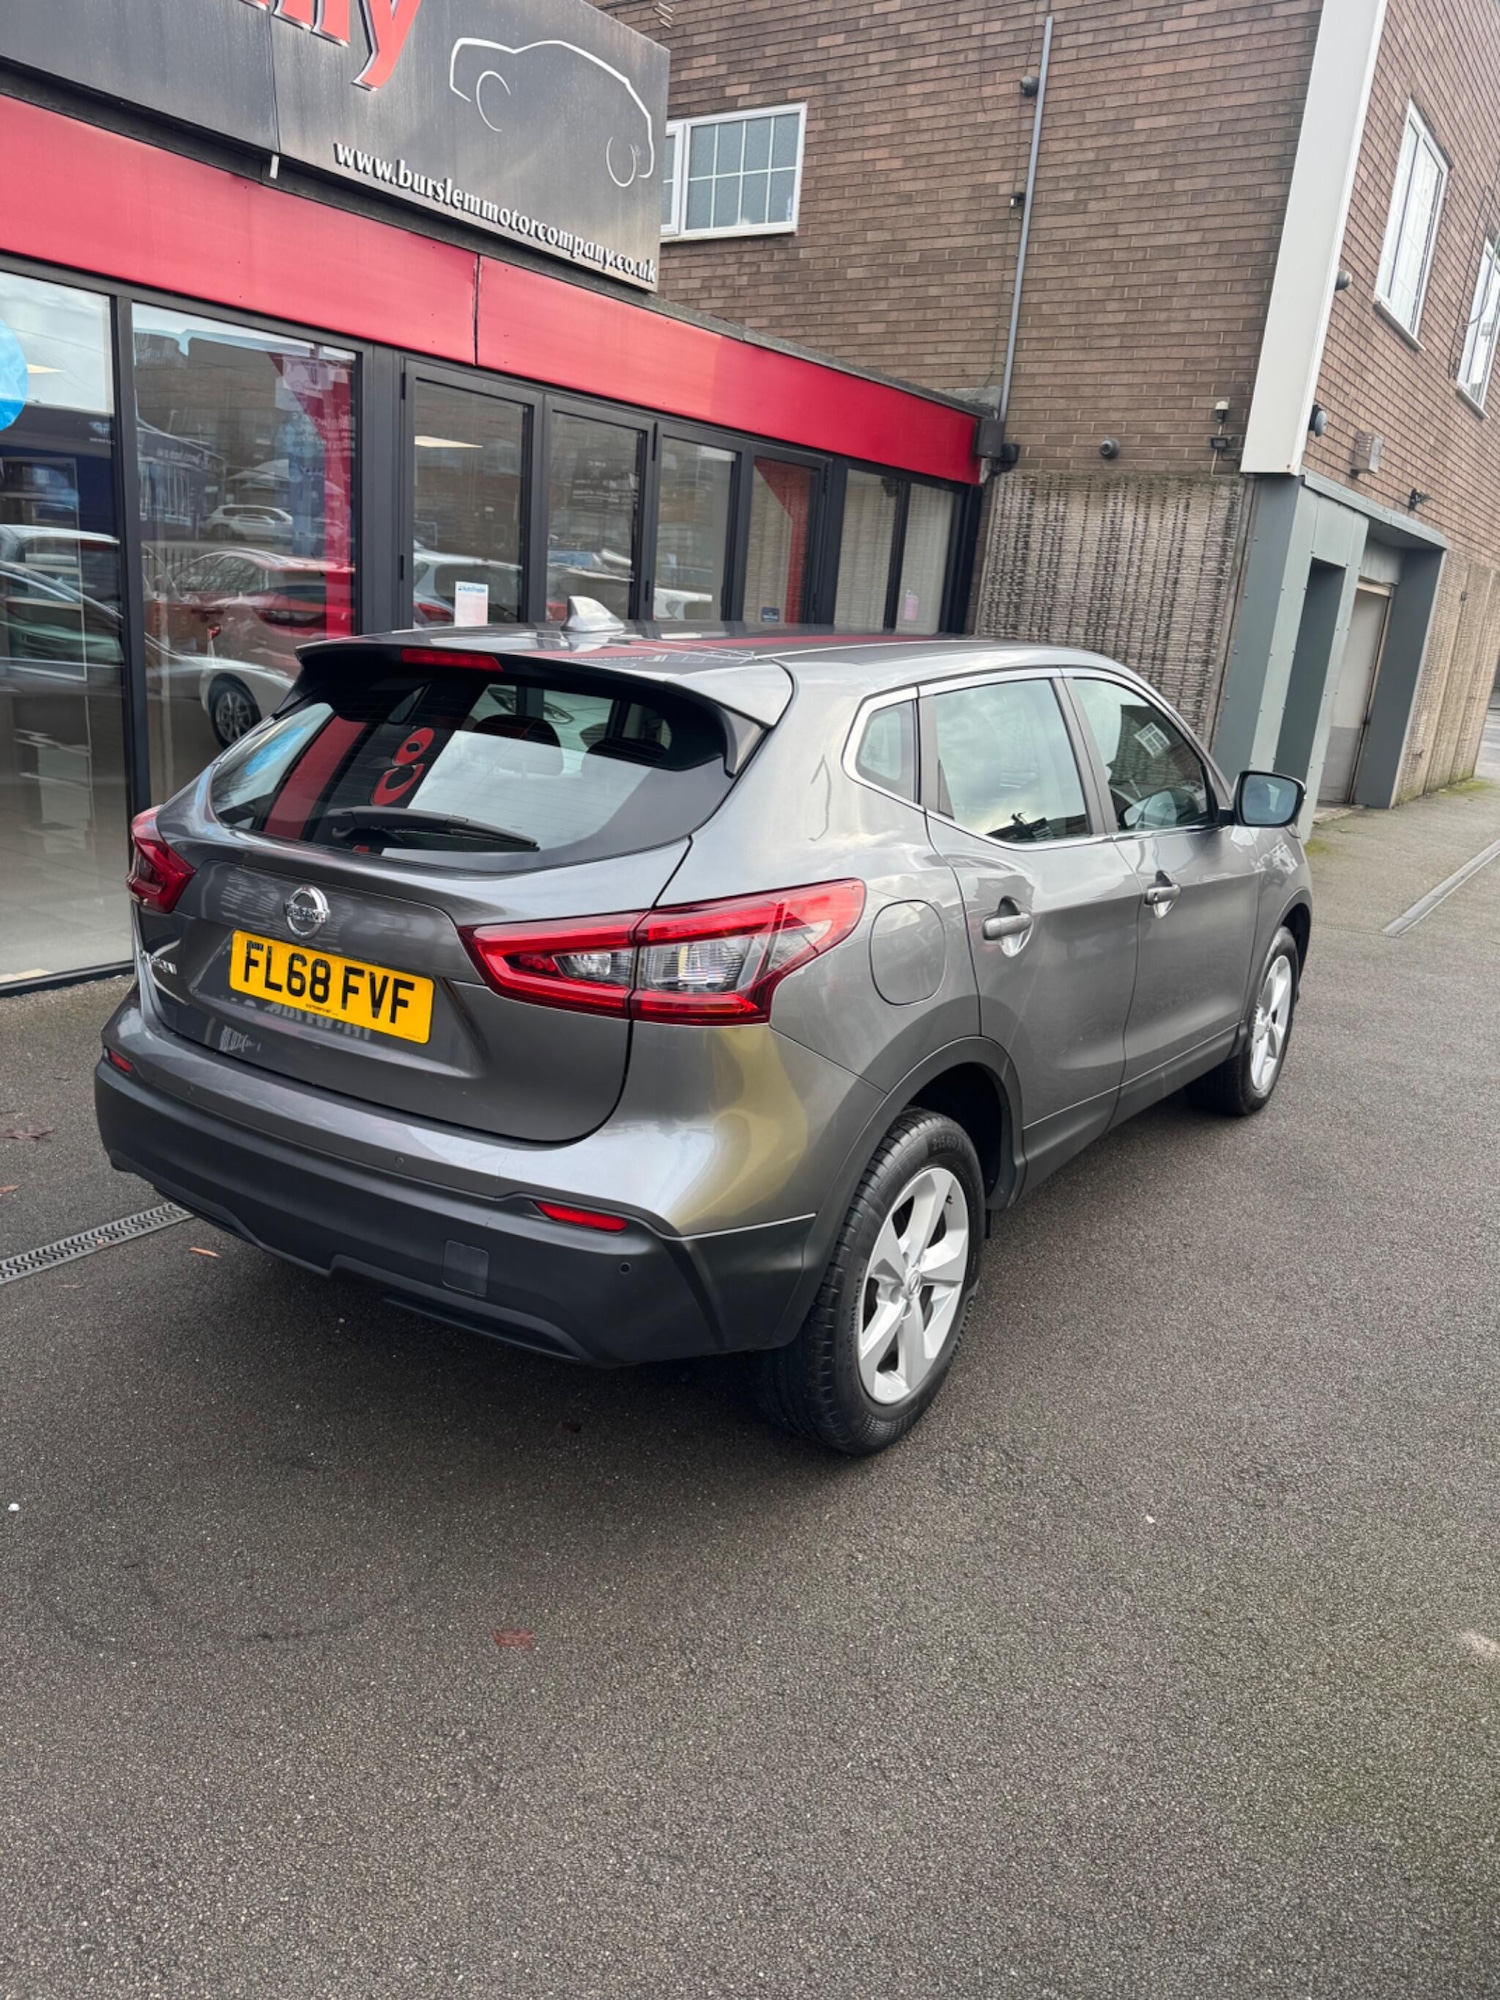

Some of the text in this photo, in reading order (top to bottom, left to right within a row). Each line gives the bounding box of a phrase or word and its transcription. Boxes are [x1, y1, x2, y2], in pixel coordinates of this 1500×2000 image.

[333, 142, 657, 283] www.burslemmotorcompany.co.uk
[243, 939, 415, 1024] FL68 FVF
